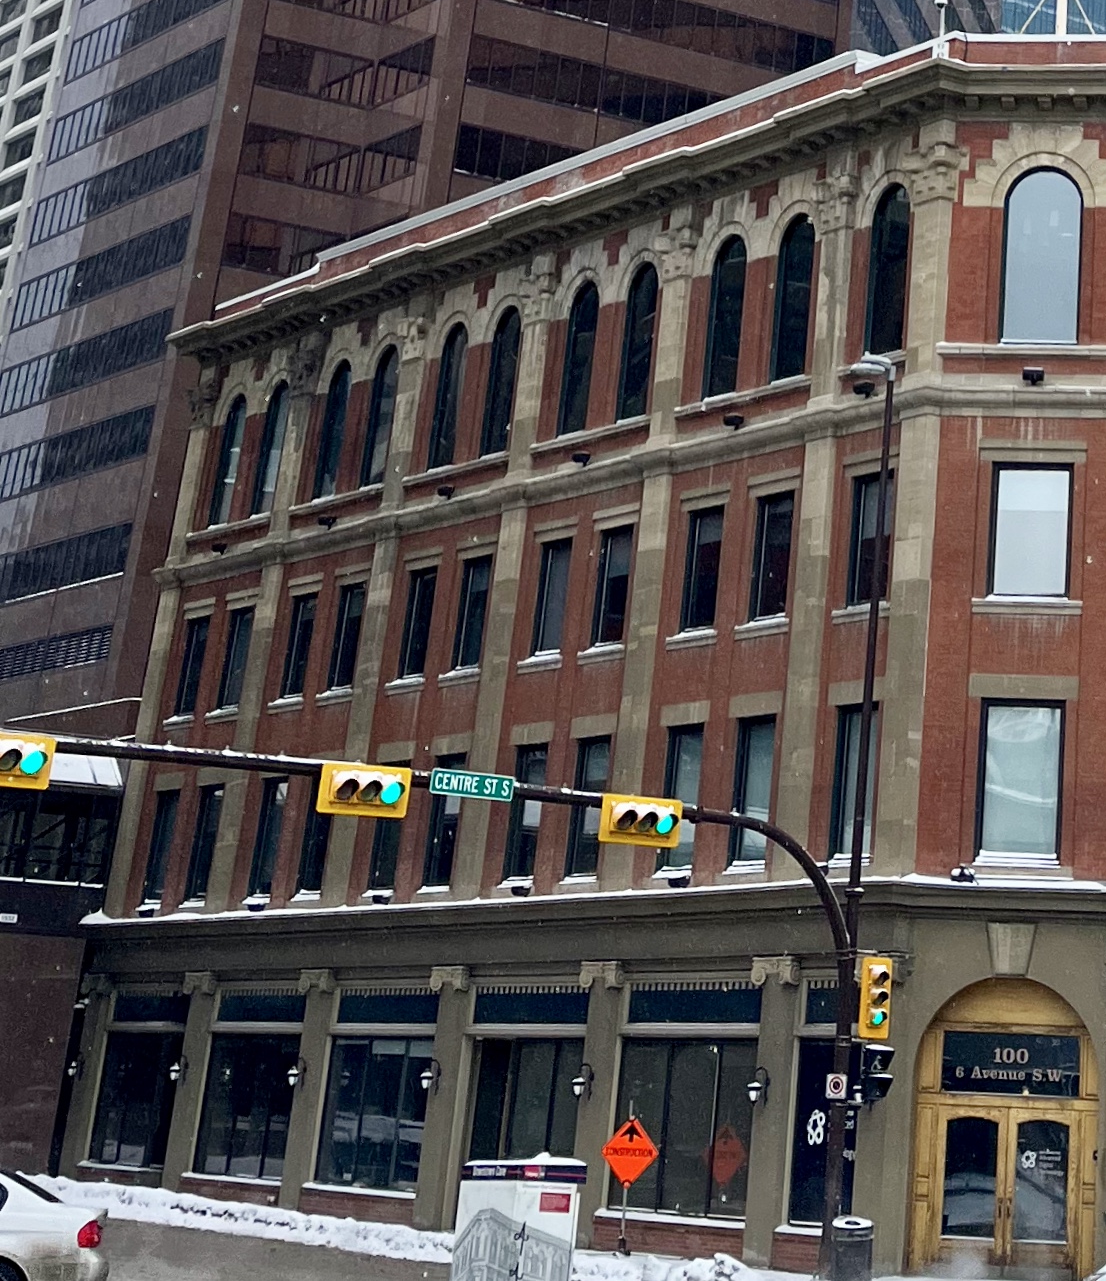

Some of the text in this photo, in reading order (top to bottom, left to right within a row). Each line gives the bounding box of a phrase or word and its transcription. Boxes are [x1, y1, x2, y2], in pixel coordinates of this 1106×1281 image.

[435, 773, 510, 796] CENTRE ST S
[992, 1047, 1029, 1064] 100
[955, 1066, 965, 1078] 6
[970, 1066, 1026, 1080] Avenue
[604, 1146, 653, 1158] CONSTRUCTION
